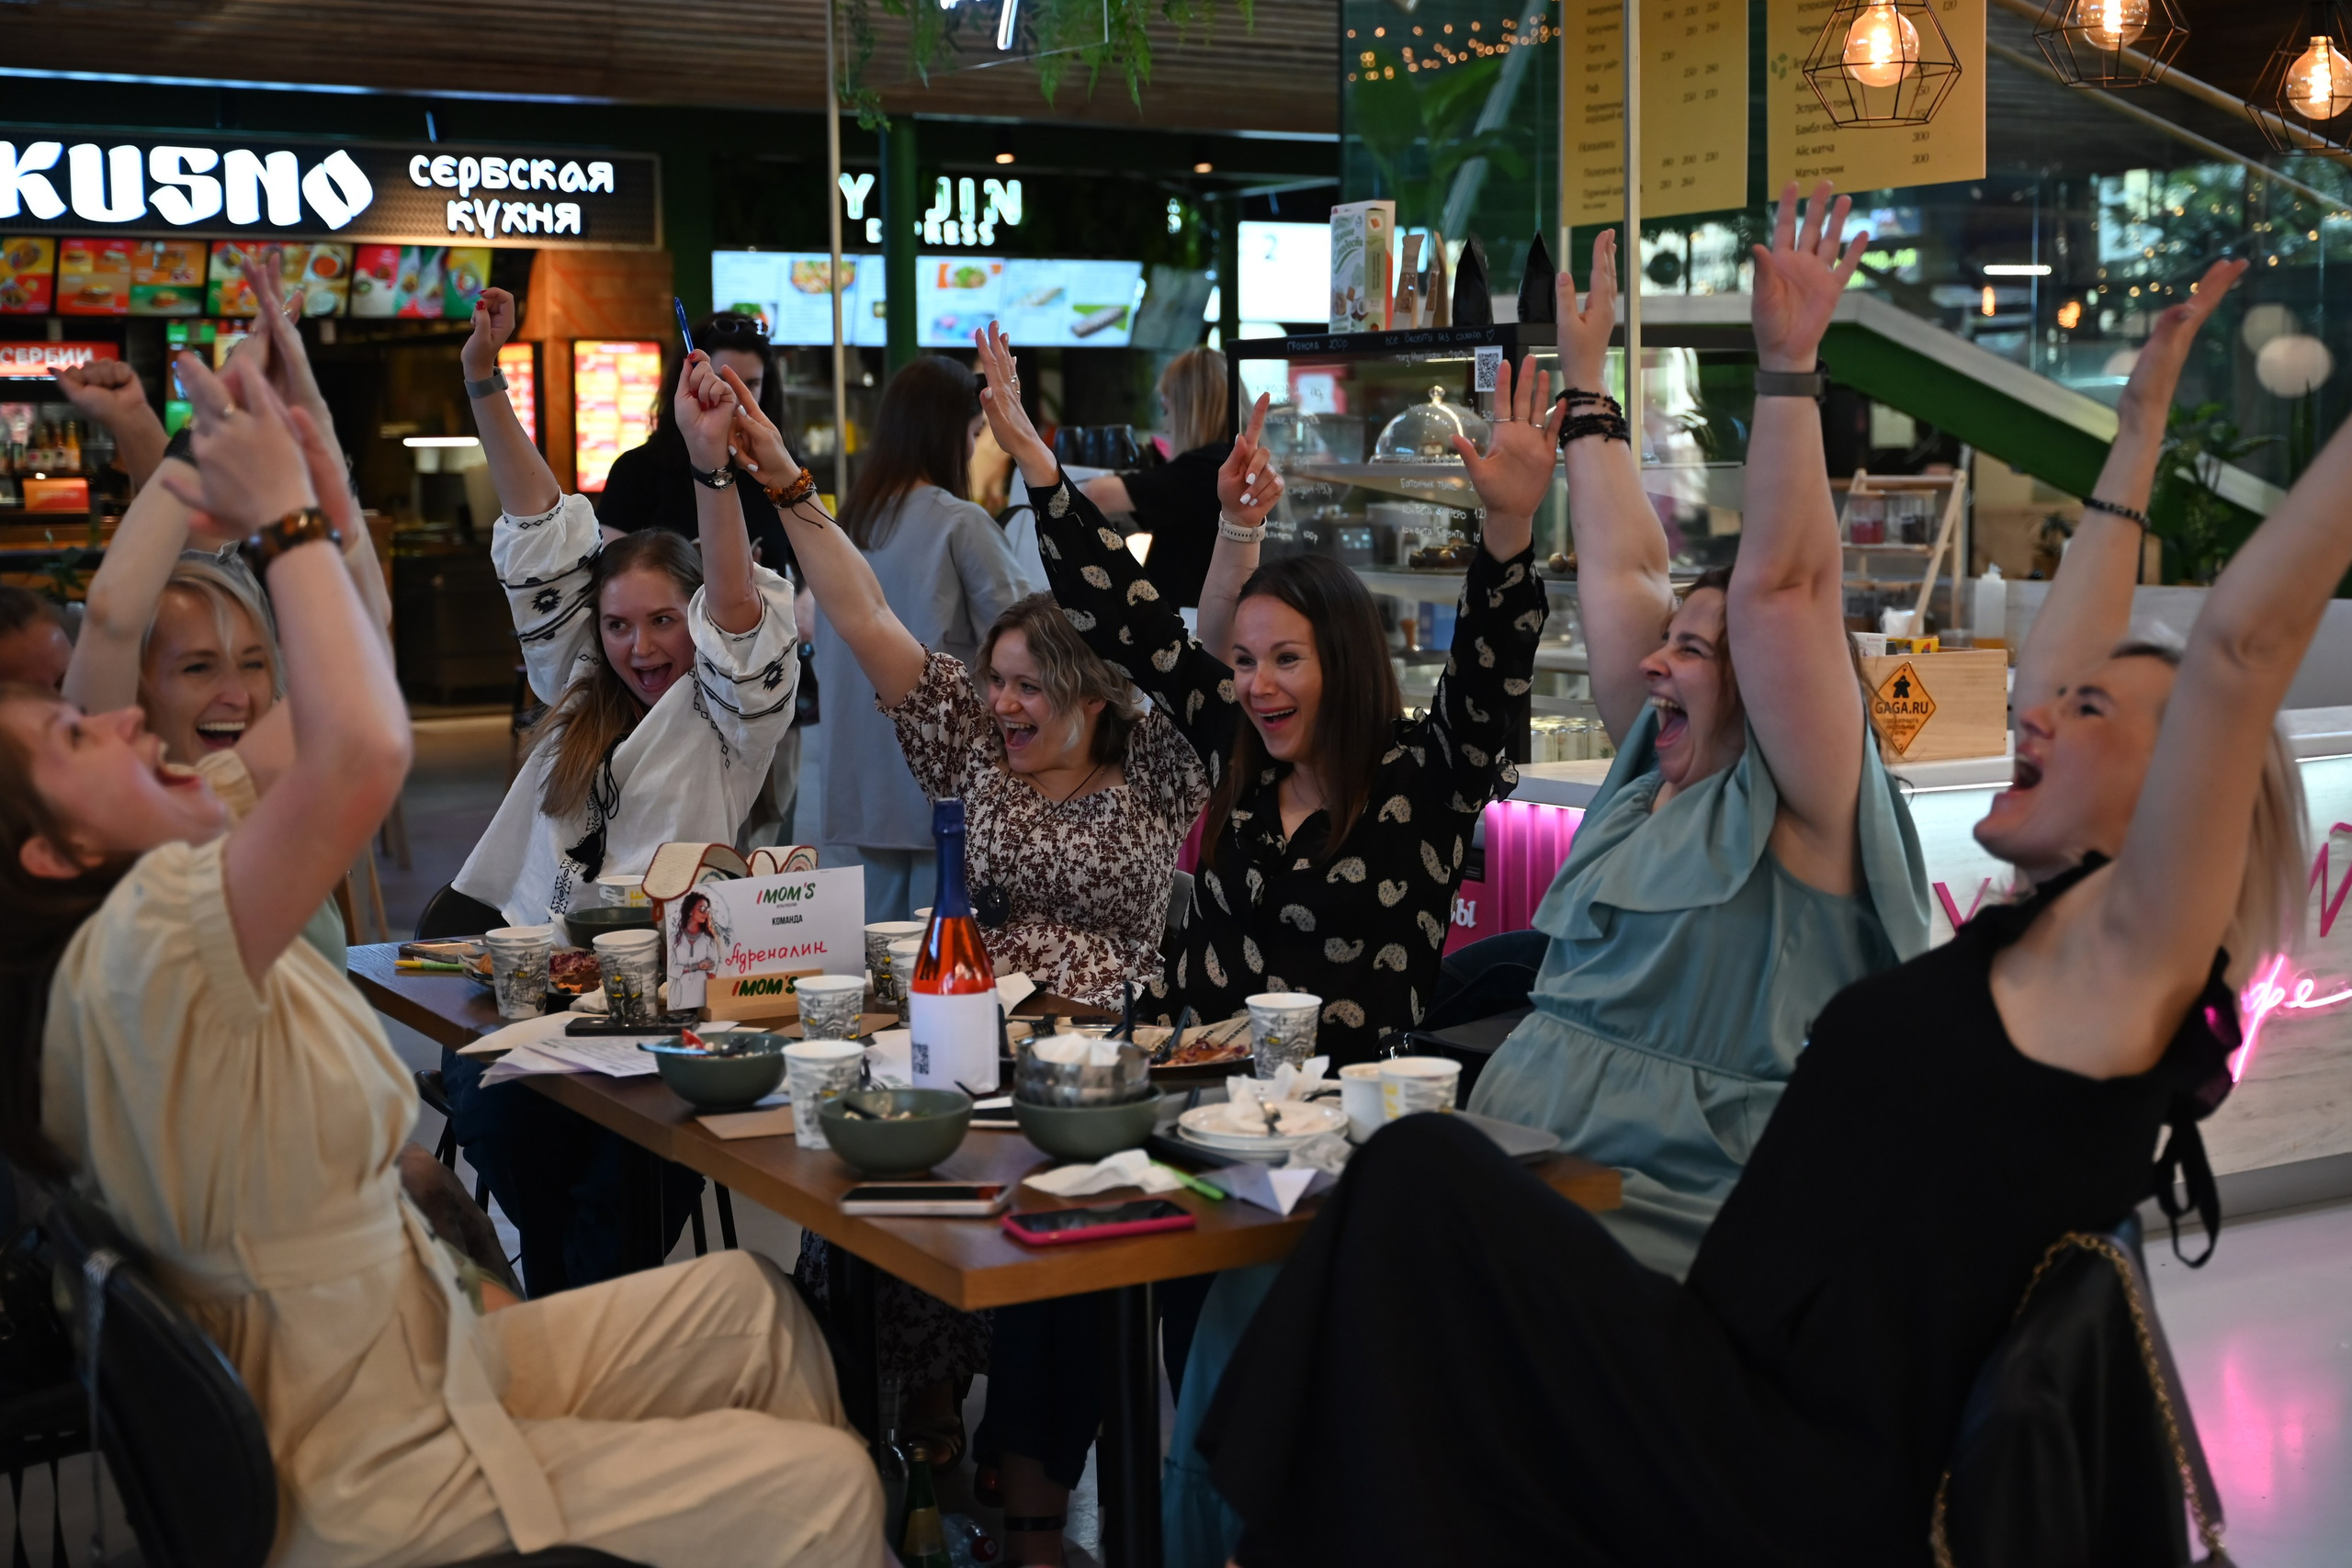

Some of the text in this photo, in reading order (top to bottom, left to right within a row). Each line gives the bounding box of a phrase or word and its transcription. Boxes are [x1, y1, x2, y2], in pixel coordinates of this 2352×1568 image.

[409, 154, 615, 197] СЕРБСКАЯ
[447, 197, 582, 240] КУХНЯ
[838, 173, 1023, 226] YJIN
[1875, 701, 1928, 715] GAGA.RU
[772, 914, 803, 926] КОМАНДА
[725, 941, 828, 975] Адреналин
